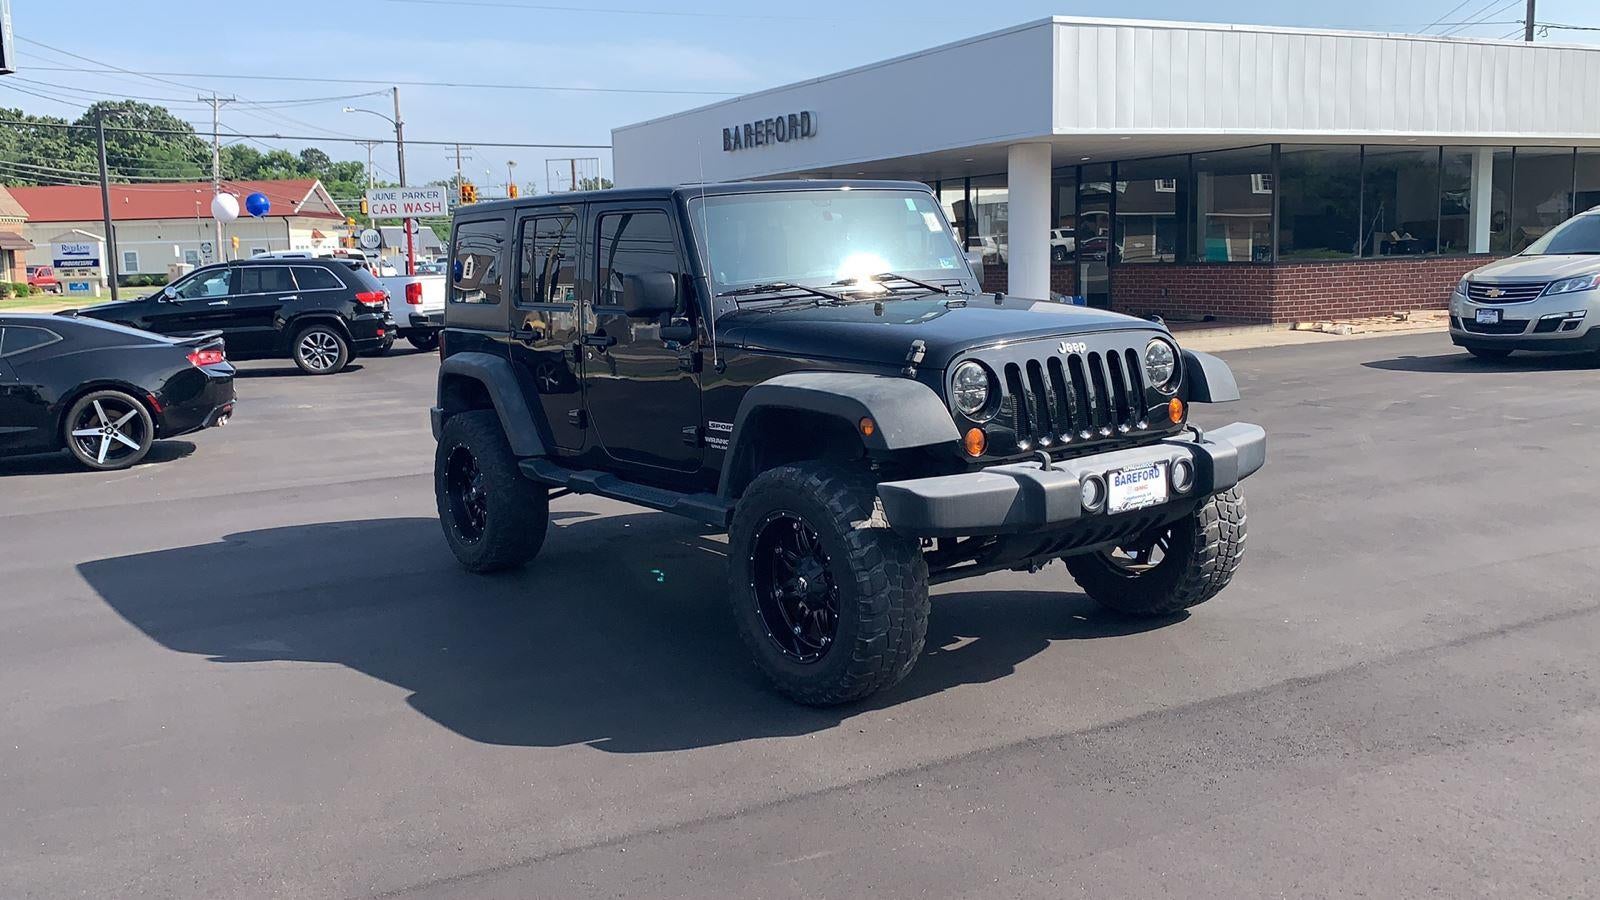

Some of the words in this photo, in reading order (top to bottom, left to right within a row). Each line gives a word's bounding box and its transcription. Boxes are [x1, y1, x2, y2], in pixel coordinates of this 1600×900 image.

[722, 111, 815, 152] BAREFORD
[372, 192, 396, 201] JUNE
[401, 191, 439, 199] PARKER
[372, 203, 397, 214] CAR
[403, 202, 442, 213] WASH
[363, 234, 378, 242] 1010
[1057, 341, 1087, 354] Jeep
[1115, 468, 1160, 487] BAREFORD
